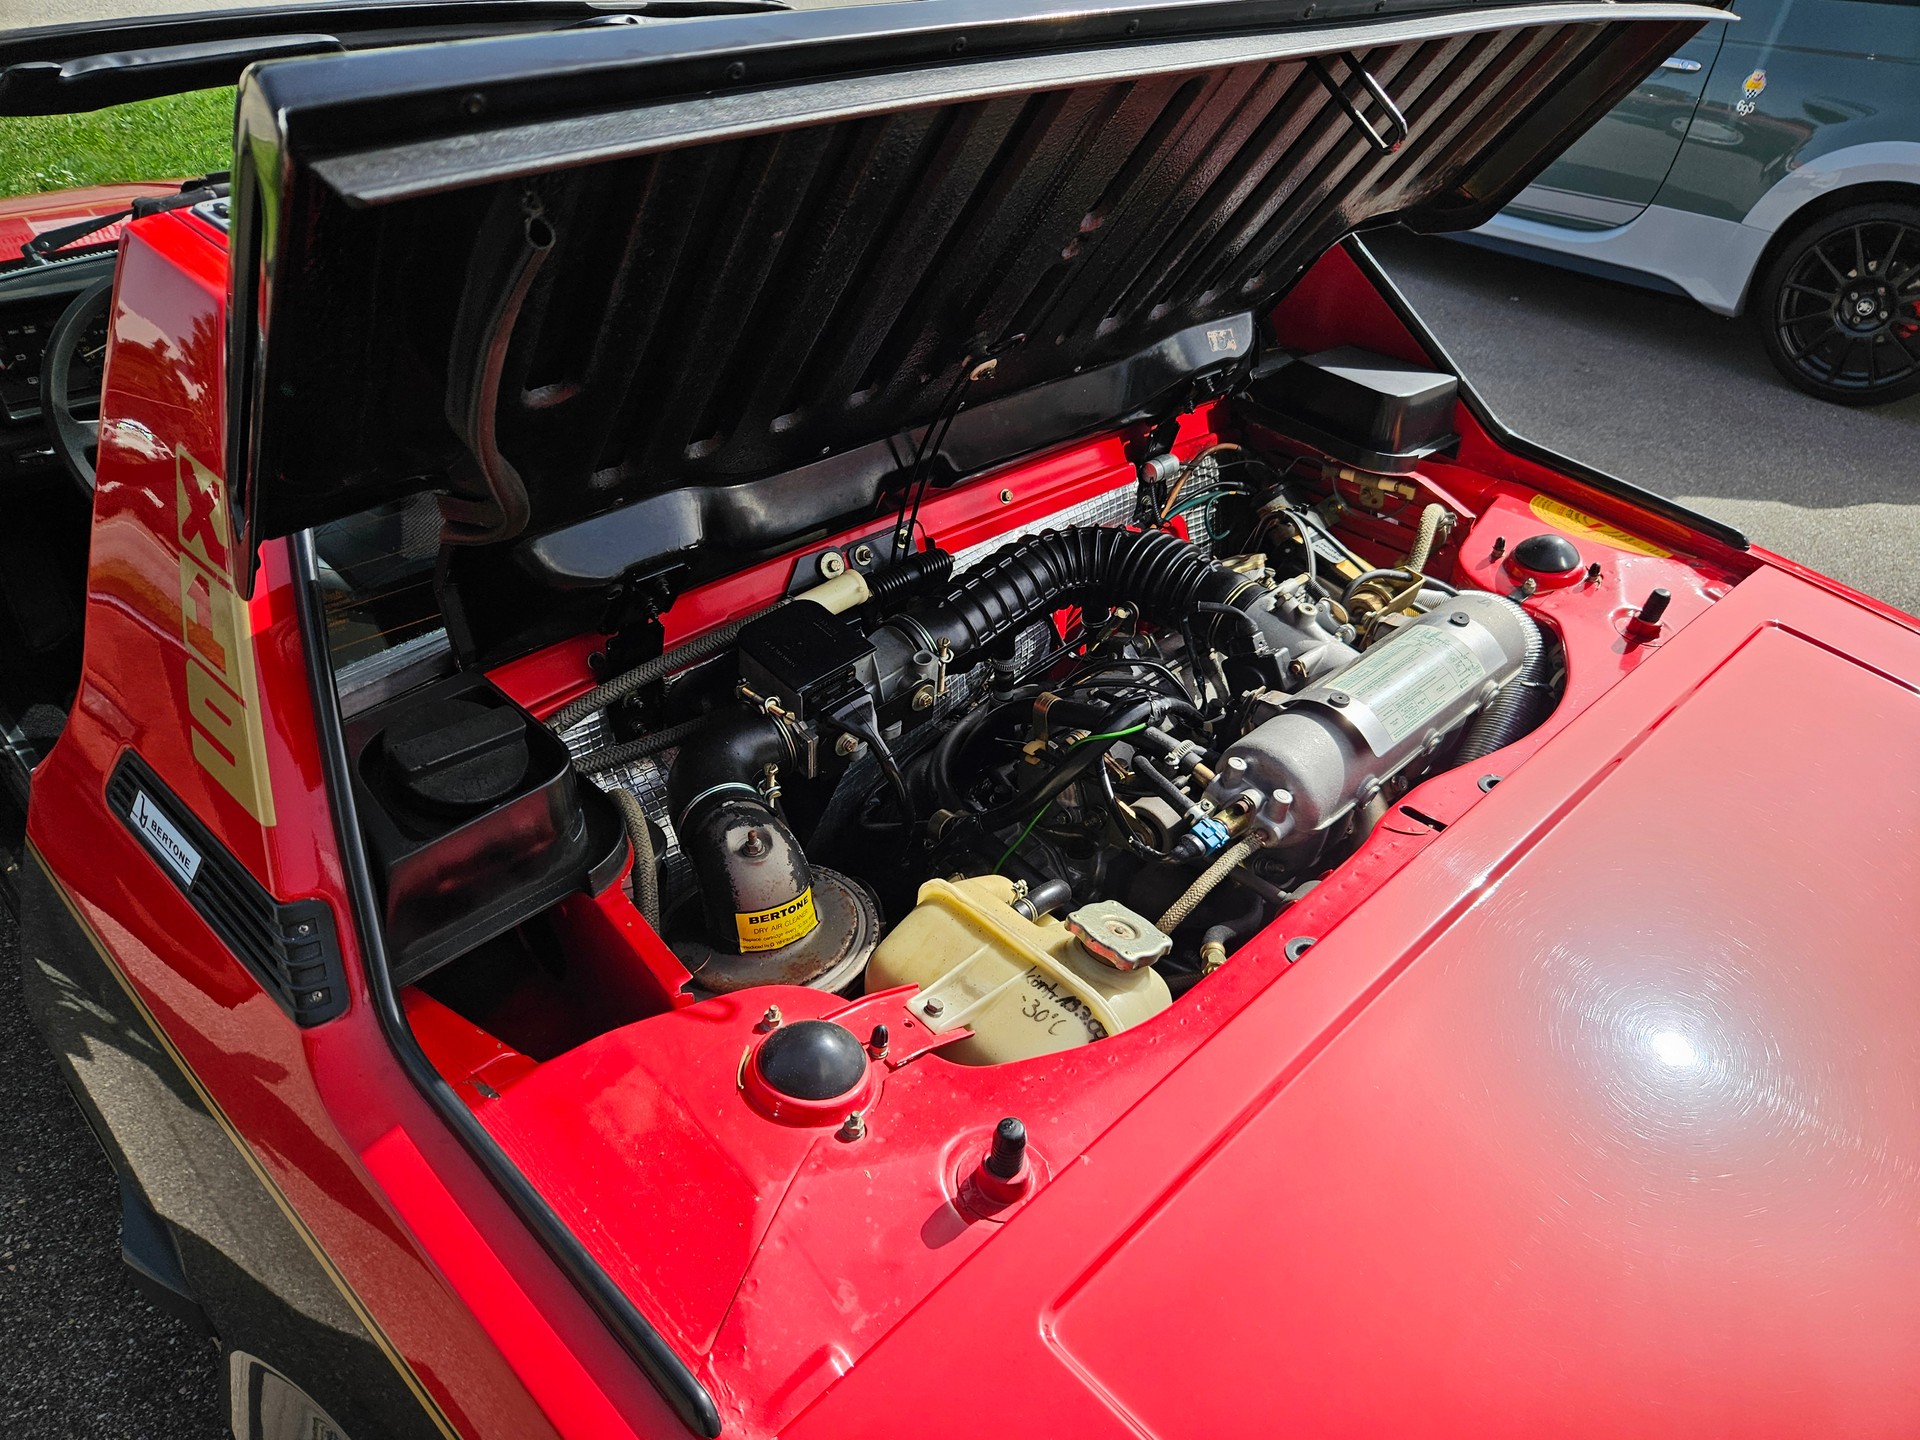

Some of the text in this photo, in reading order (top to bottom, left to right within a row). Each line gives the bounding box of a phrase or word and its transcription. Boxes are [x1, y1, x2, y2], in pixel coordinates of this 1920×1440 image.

[1736, 100, 1756, 116] 695
[150, 819, 192, 871] BERTONE
[748, 895, 809, 925] BERTONE
[753, 927, 769, 935] DRY
[771, 922, 783, 931] AIR
[784, 908, 808, 928] CLEANER
